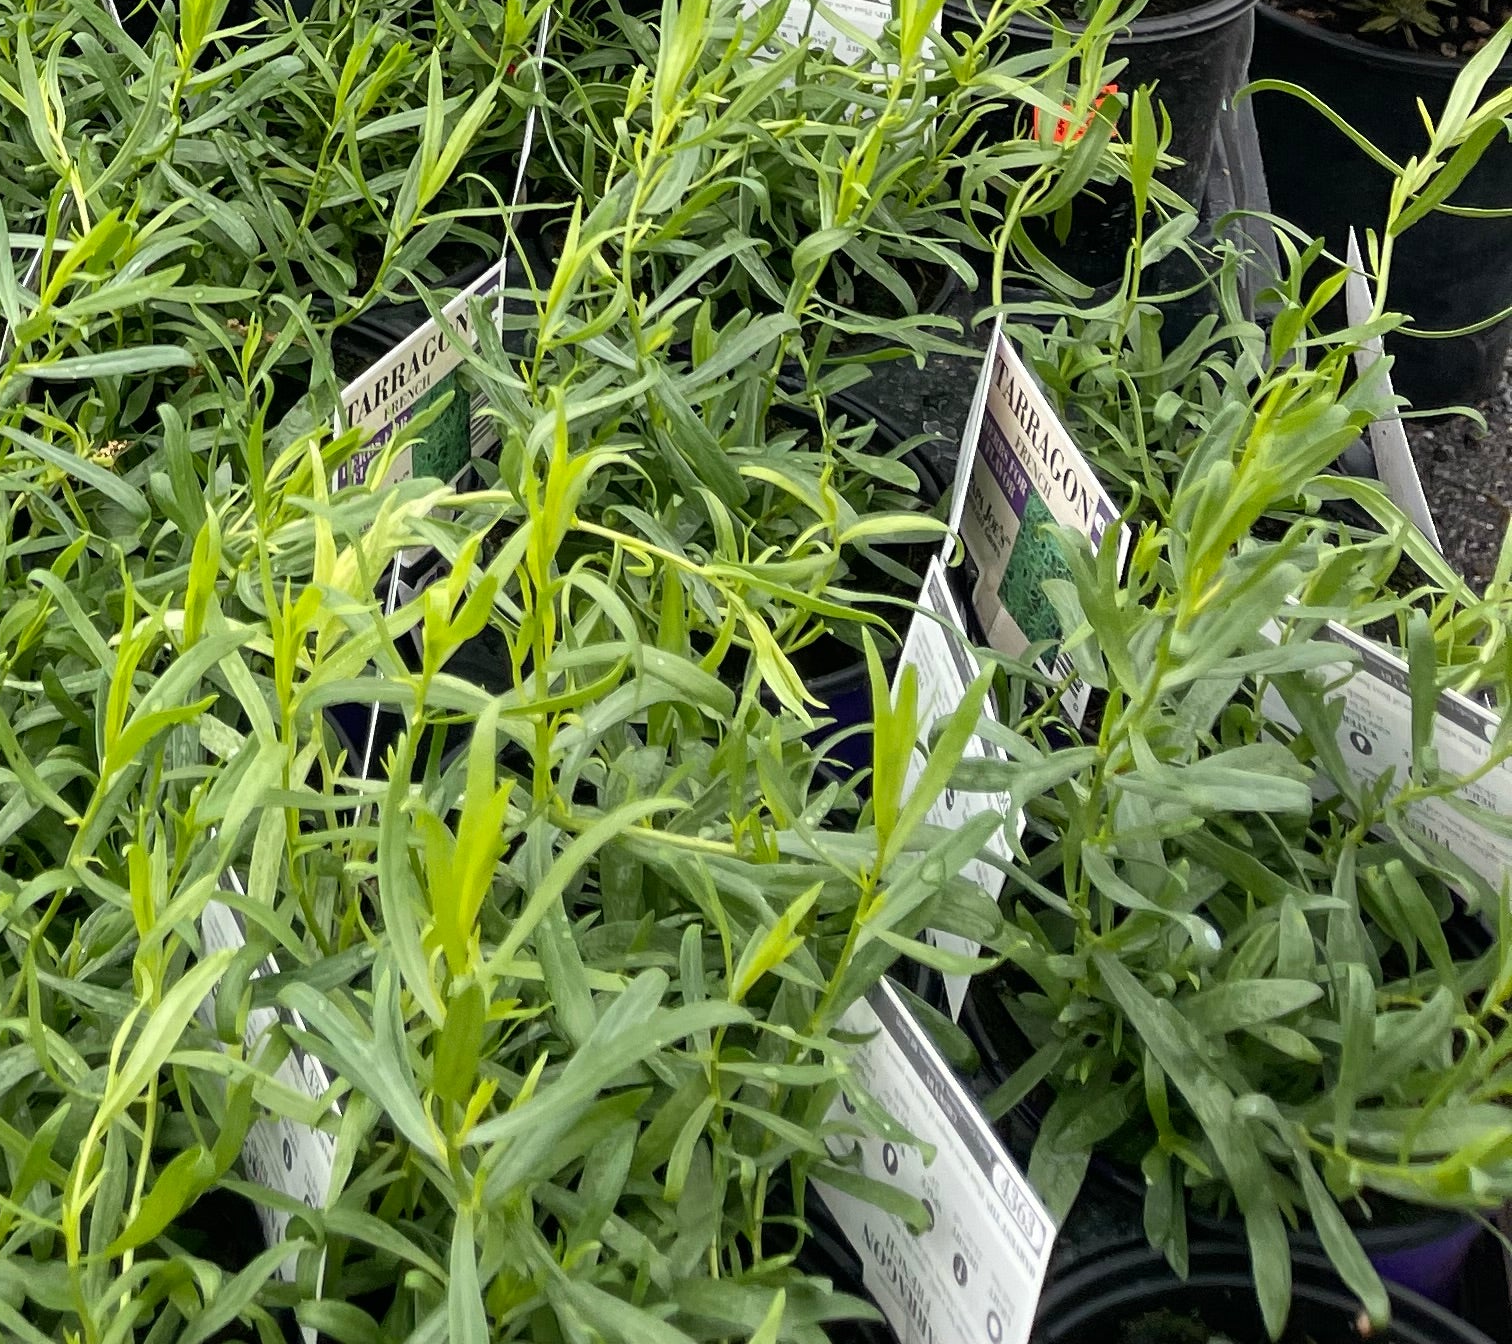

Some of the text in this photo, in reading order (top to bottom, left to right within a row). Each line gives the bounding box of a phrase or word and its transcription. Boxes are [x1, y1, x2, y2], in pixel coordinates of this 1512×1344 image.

[346, 307, 469, 428] TARRAGON
[995, 354, 1095, 527] TARRAGON
[1009, 458, 1028, 497] FOR
[1014, 434, 1053, 501] FRENCH
[1000, 1176, 1036, 1239] 4363
[886, 1232, 932, 1319] FRENCH
